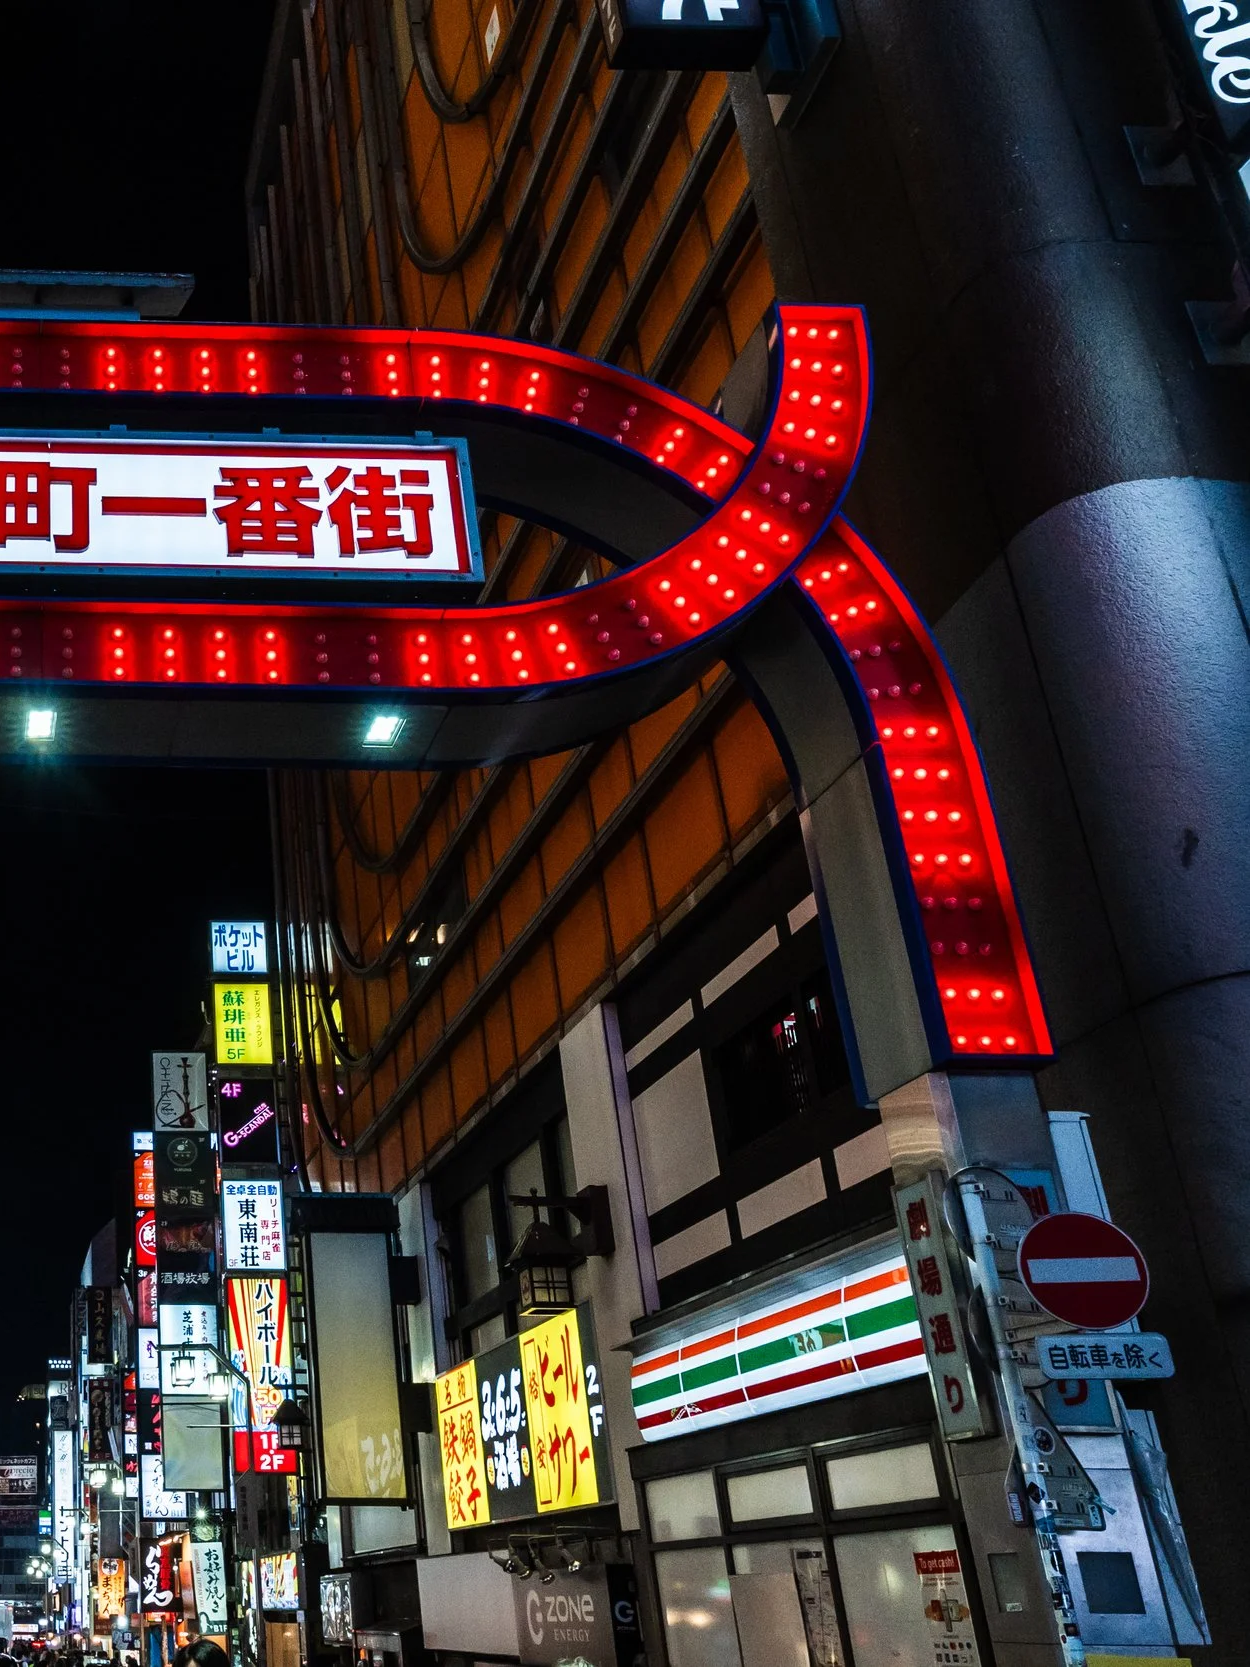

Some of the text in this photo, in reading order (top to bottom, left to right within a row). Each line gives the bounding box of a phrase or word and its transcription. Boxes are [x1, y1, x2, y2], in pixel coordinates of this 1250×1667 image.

[214, 925, 263, 947] ポケット
[226, 949, 255, 971] ビル
[227, 1048, 245, 1060] 5F
[221, 1083, 242, 1097] 4F
[226, 1184, 277, 1195] 全卓全自動
[238, 1199, 259, 1267] 東南荘
[254, 1282, 279, 1385] ハイボール
[537, 1324, 580, 1407] ビール
[1049, 1344, 1164, 1371] 自転車を除く
[260, 1455, 285, 1470] 2F
[203, 1549, 225, 1614] お好み焼き
[553, 1628, 591, 1642] ENERGY
